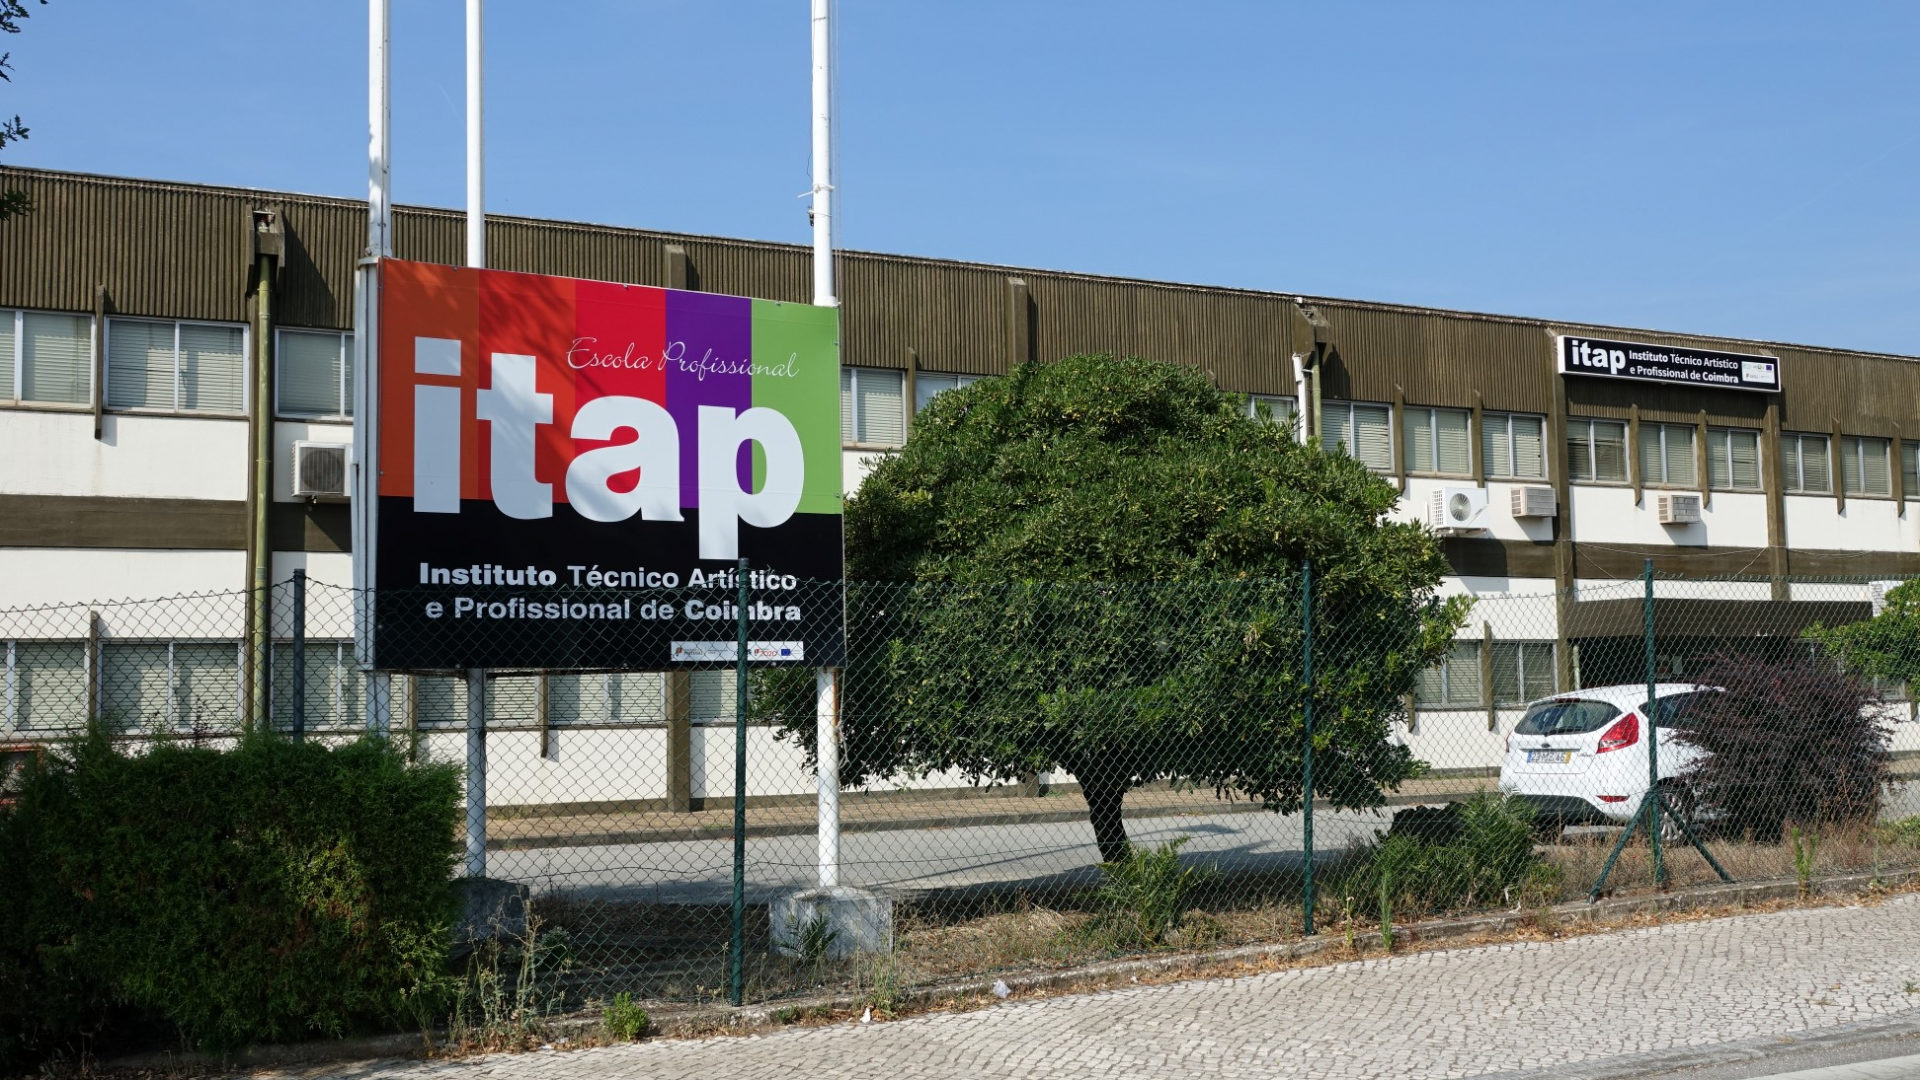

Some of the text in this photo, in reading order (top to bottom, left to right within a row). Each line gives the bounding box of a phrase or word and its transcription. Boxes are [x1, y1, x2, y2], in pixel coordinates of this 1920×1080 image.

[566, 337, 799, 381] Escola Profissional
[1571, 340, 1626, 375] itap
[1629, 350, 1668, 363] Instituto
[1670, 353, 1702, 366] Técnico
[1703, 357, 1738, 370] Artístico
[1637, 366, 1688, 380] Profissional
[1690, 371, 1700, 380] de
[1702, 372, 1739, 384] Coimbra
[414, 336, 804, 560] itap
[419, 563, 797, 590] Instituto Técnico Artítico
[425, 602, 443, 618] e
[454, 597, 630, 620] Profissional
[640, 599, 674, 620] de
